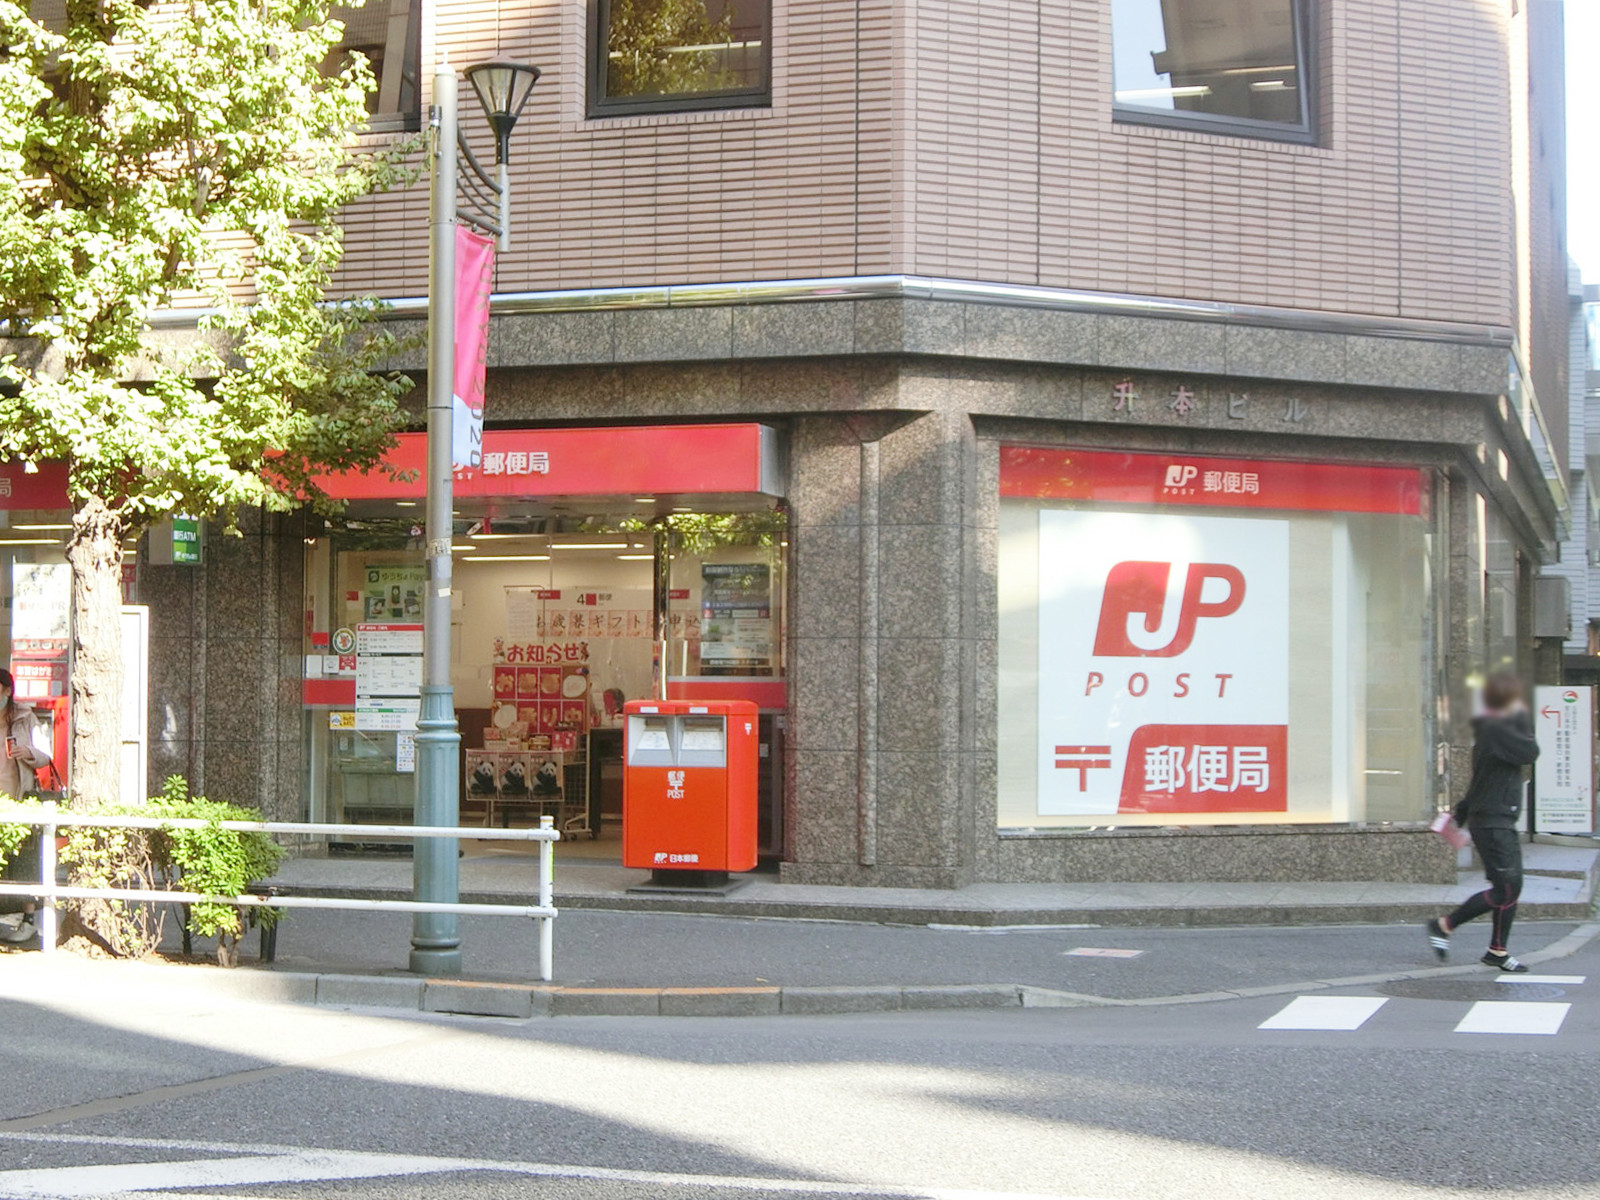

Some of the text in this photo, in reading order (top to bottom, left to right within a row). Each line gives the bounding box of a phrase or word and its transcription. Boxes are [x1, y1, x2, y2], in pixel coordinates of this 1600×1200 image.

[1112, 381, 1308, 422] 升本ビル
[470, 376, 485, 468] 2020
[483, 451, 549, 475] 郵便局
[1163, 487, 1195, 495] POST
[1203, 471, 1259, 494] 郵便局
[577, 593, 585, 605] 4
[1092, 560, 1247, 658] JP
[506, 642, 580, 663] お知らせ
[1085, 671, 1233, 699] POST
[1144, 744, 1270, 793] 郵便局
[667, 789, 685, 799] POST
